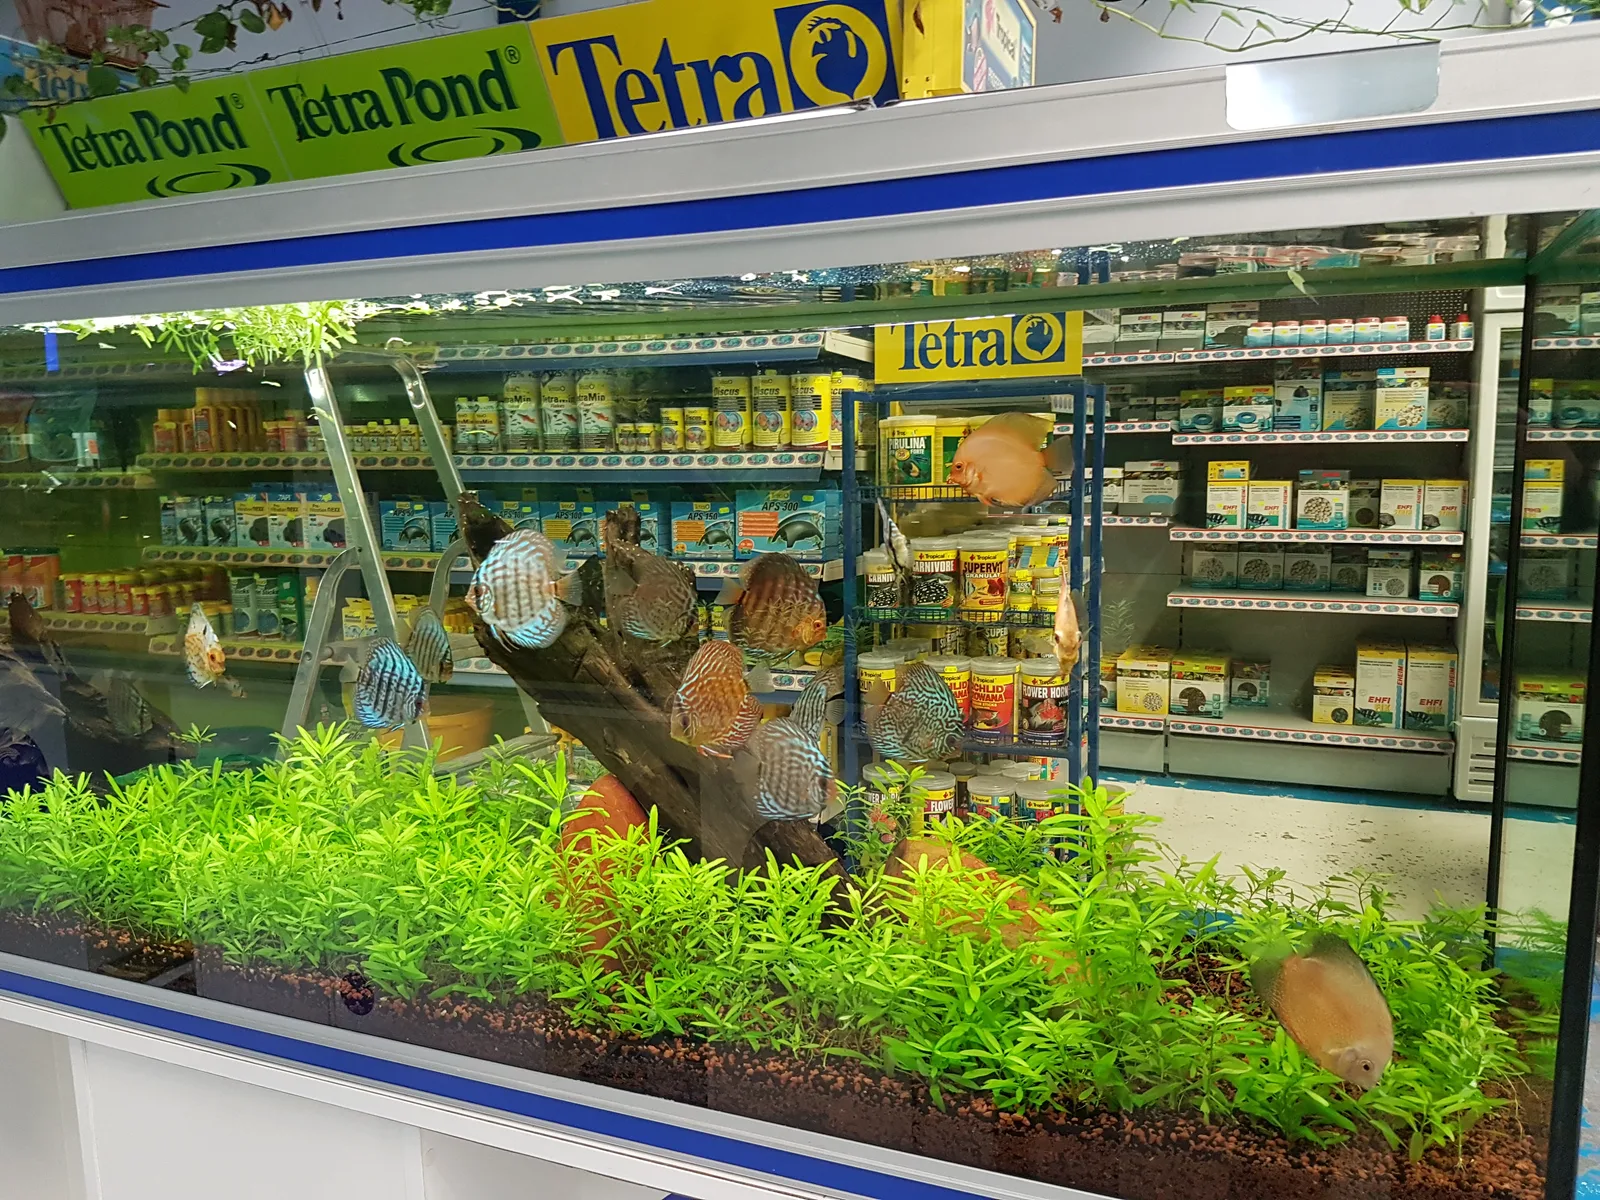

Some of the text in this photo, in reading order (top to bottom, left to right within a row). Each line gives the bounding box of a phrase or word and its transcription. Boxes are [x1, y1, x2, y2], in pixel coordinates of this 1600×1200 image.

[546, 35, 783, 140] Tetra
[889, 321, 1008, 371] Tetra
[762, 502, 799, 511] APS 300
[555, 511, 569, 519] APS
[688, 512, 703, 520] APS
[868, 573, 895, 583] CARNIV
[1022, 684, 1069, 698] FLOWER HORN
[1368, 696, 1391, 704] EHFI
[1419, 698, 1443, 706] EHFI
